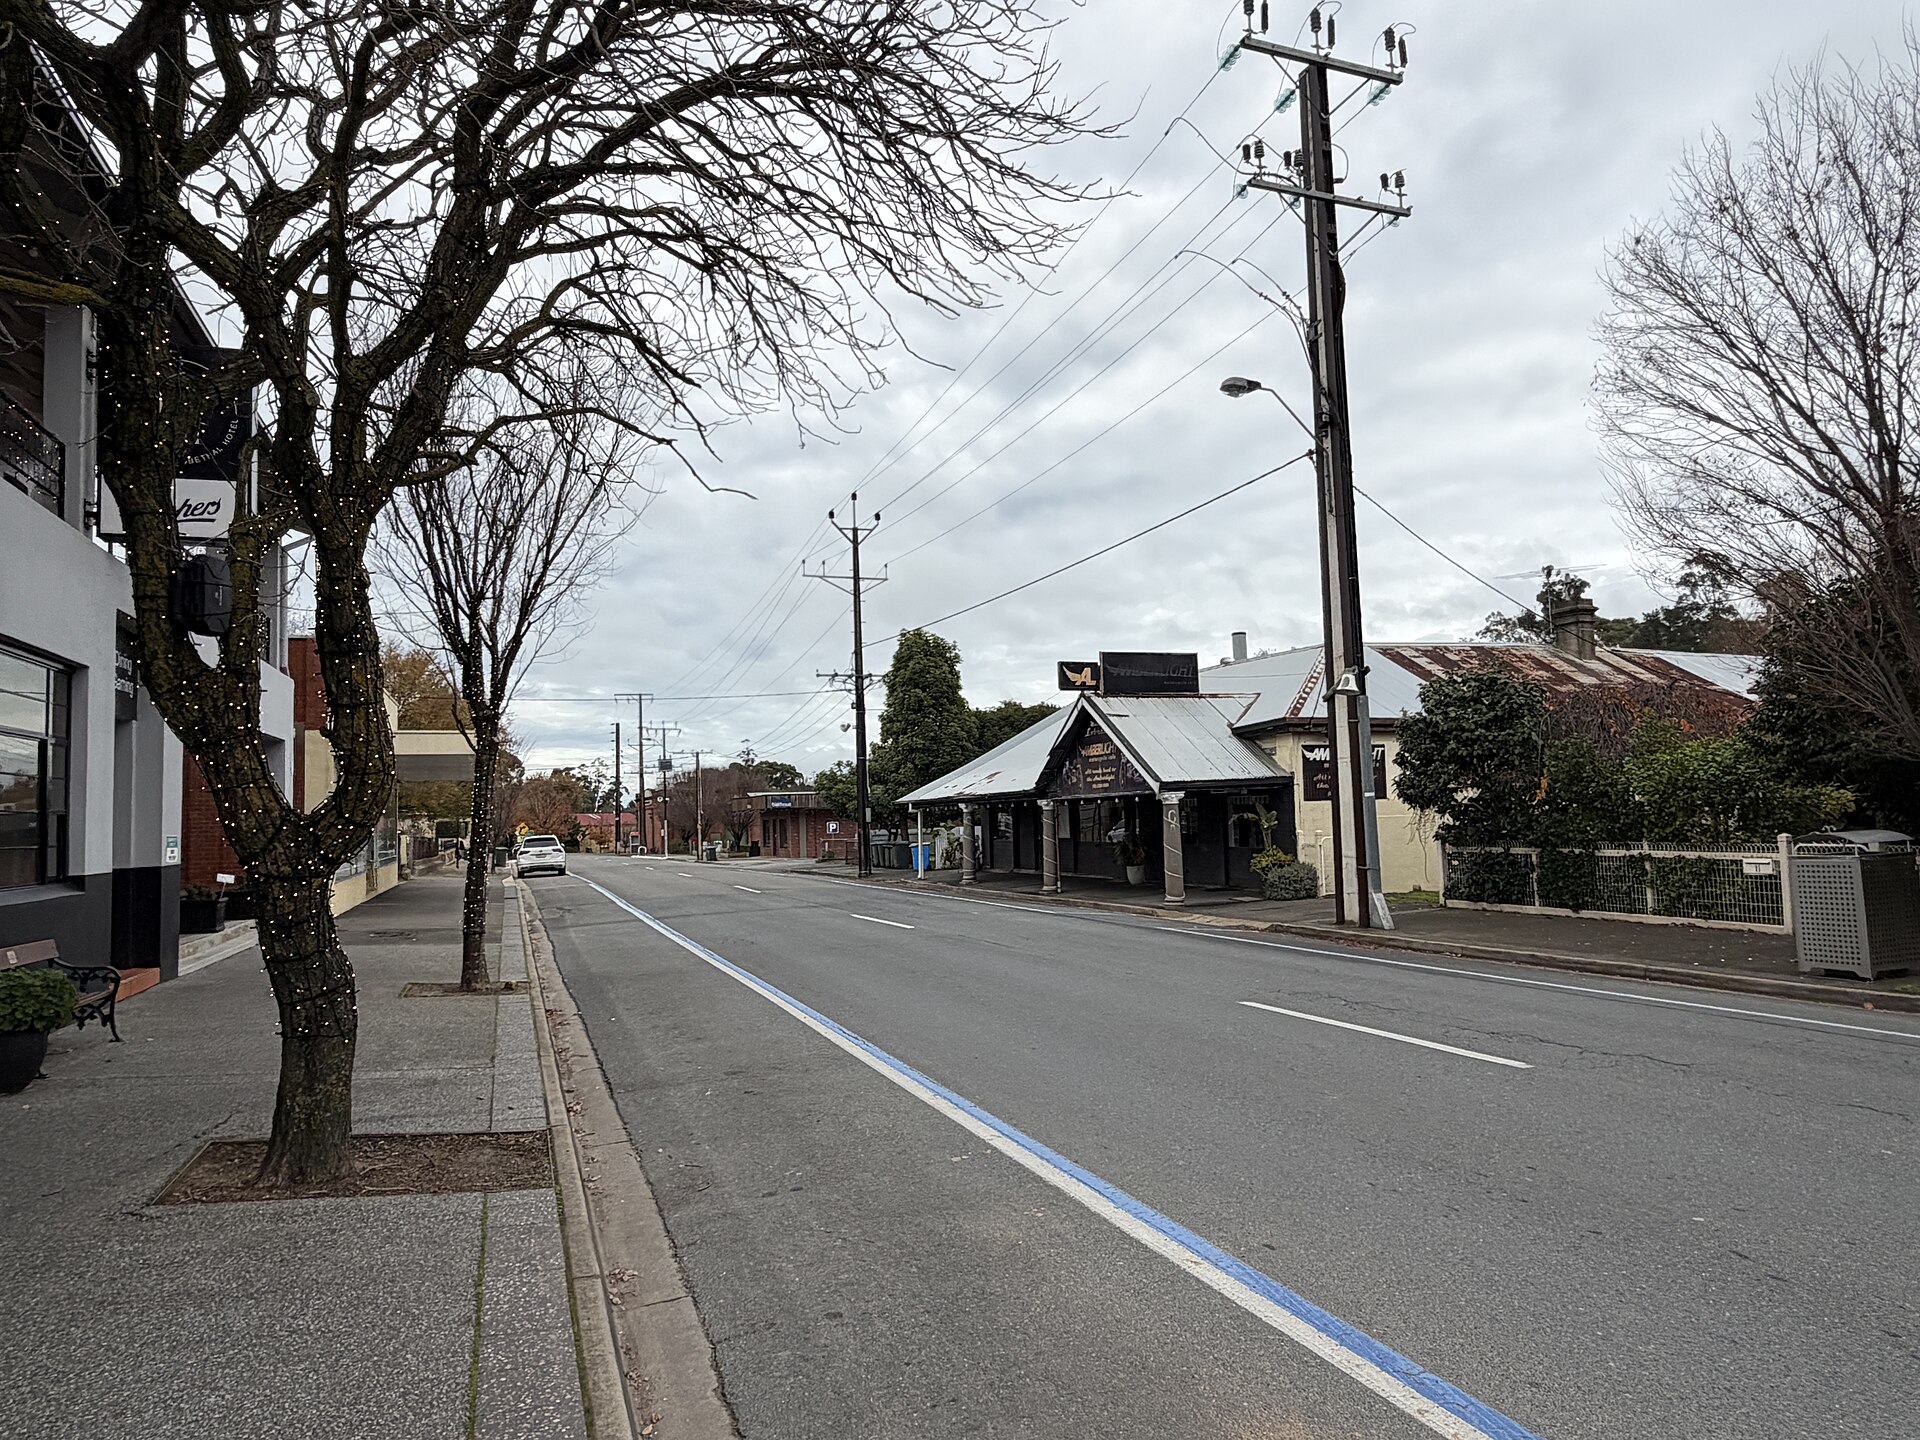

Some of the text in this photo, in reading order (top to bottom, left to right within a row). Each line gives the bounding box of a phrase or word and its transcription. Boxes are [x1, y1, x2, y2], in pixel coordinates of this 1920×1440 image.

[222, 419, 239, 445] HOTEL
[176, 498, 222, 518] hers
[829, 823, 837, 832] P
